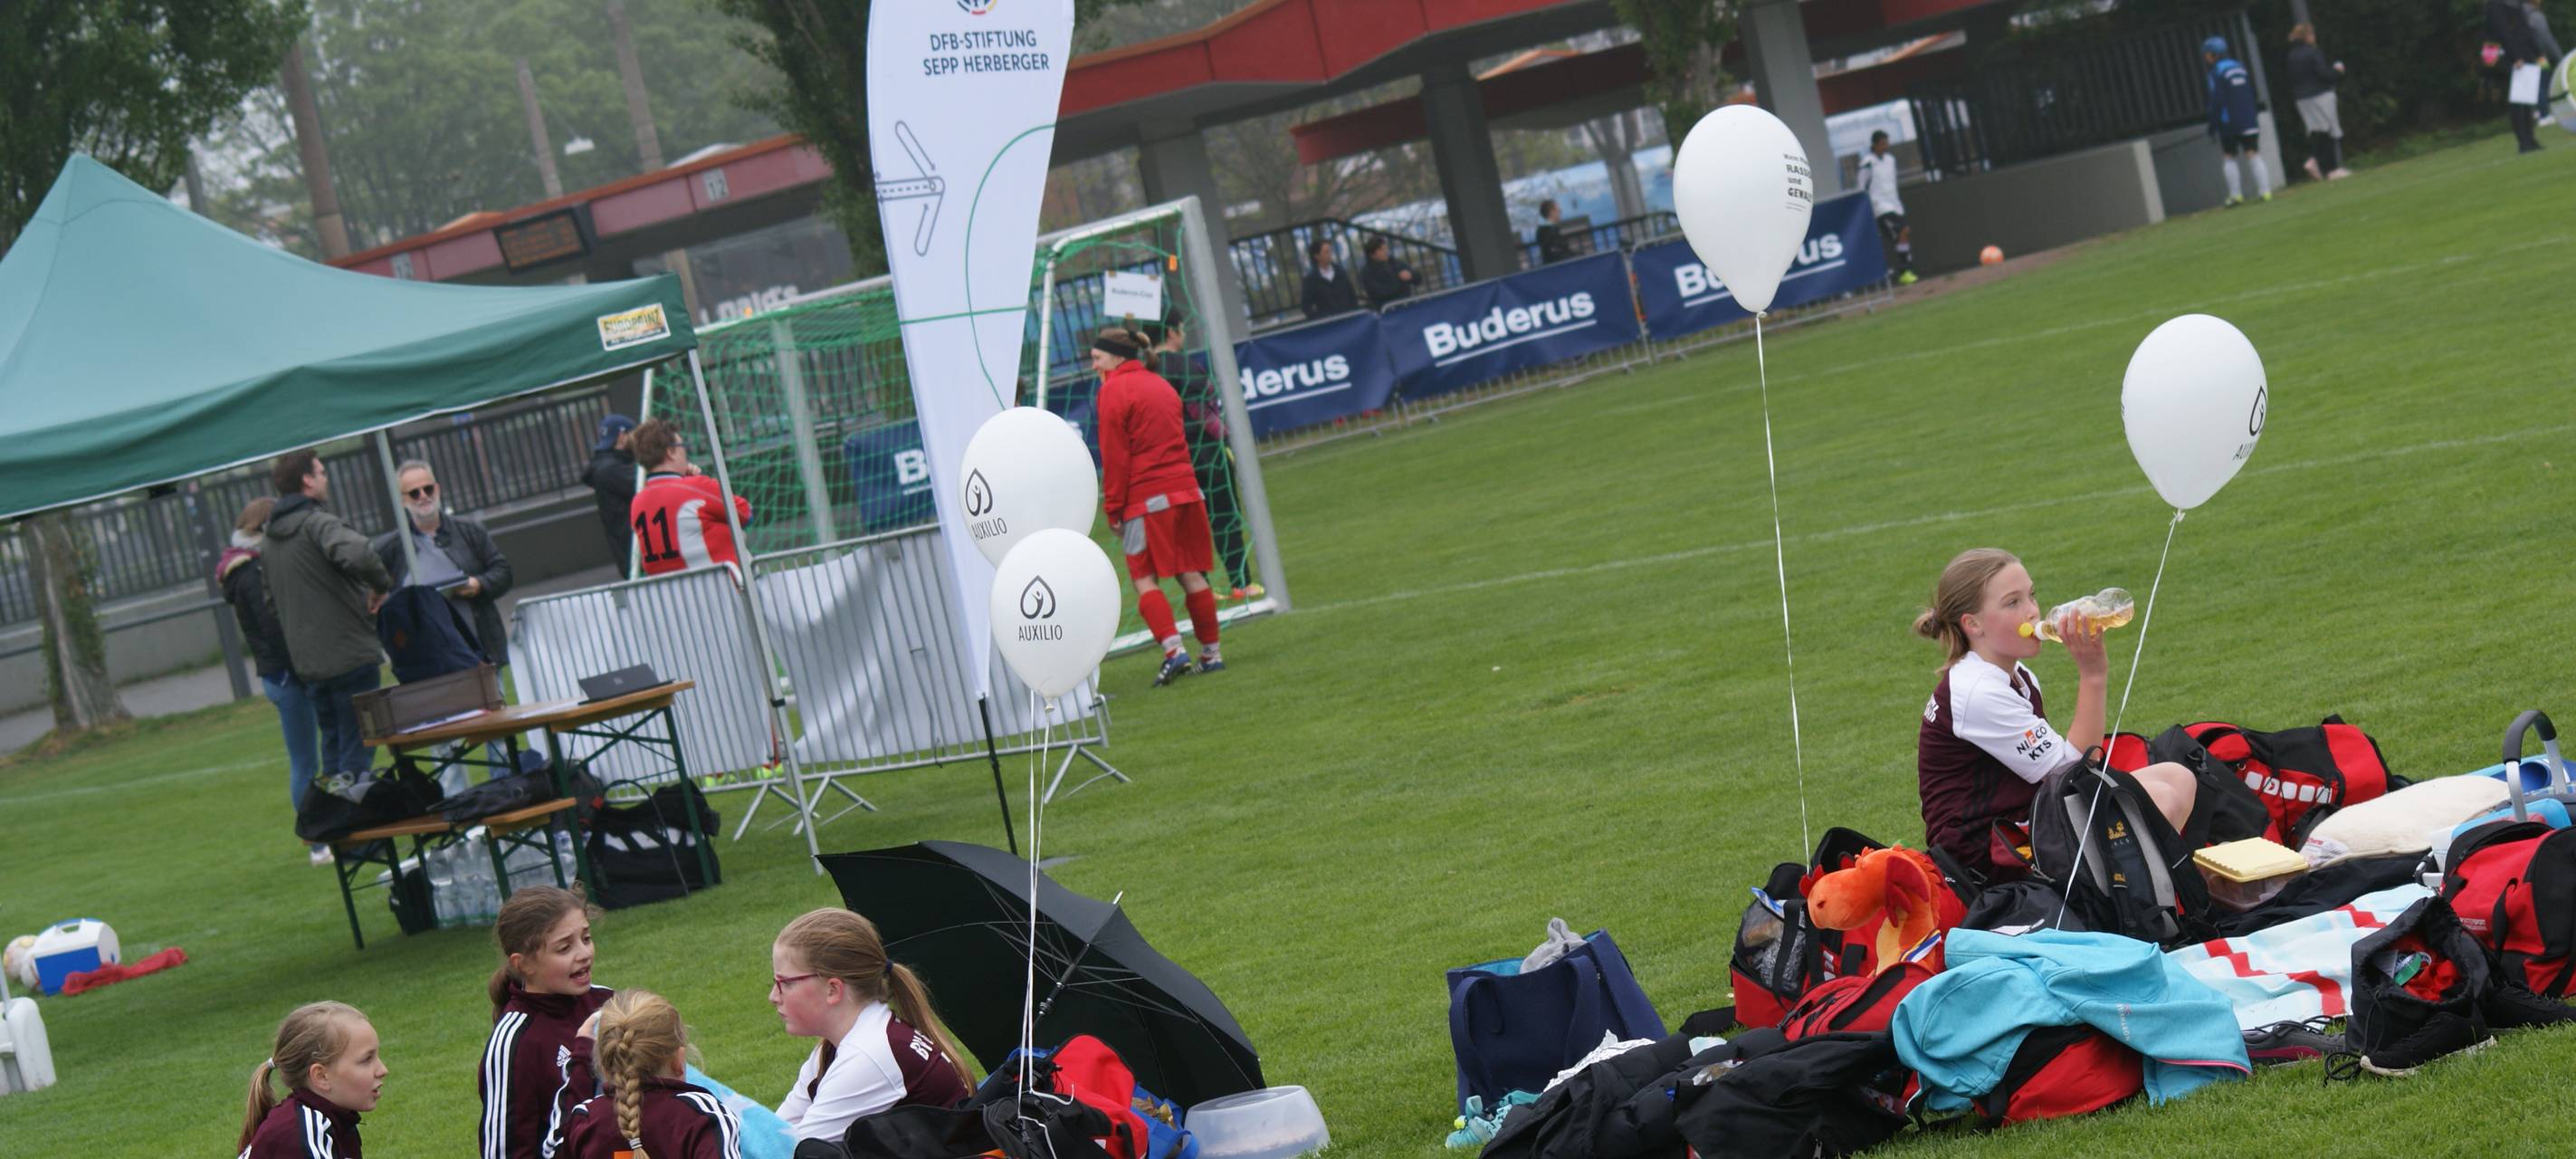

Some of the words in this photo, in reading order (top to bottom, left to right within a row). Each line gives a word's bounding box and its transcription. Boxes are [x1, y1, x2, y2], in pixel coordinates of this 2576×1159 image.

[930, 30, 1037, 52] DFB-STIFTUNG
[923, 57, 959, 76] SEPP
[963, 53, 1050, 73] HERBERGER
[1423, 292, 1596, 359] Buderus
[1239, 354, 1350, 400] derus
[635, 506, 680, 563] 11
[971, 517, 1007, 541] AUXILIO
[1018, 624, 1063, 642] AUXILIO
[2028, 739, 2053, 761] KTS
